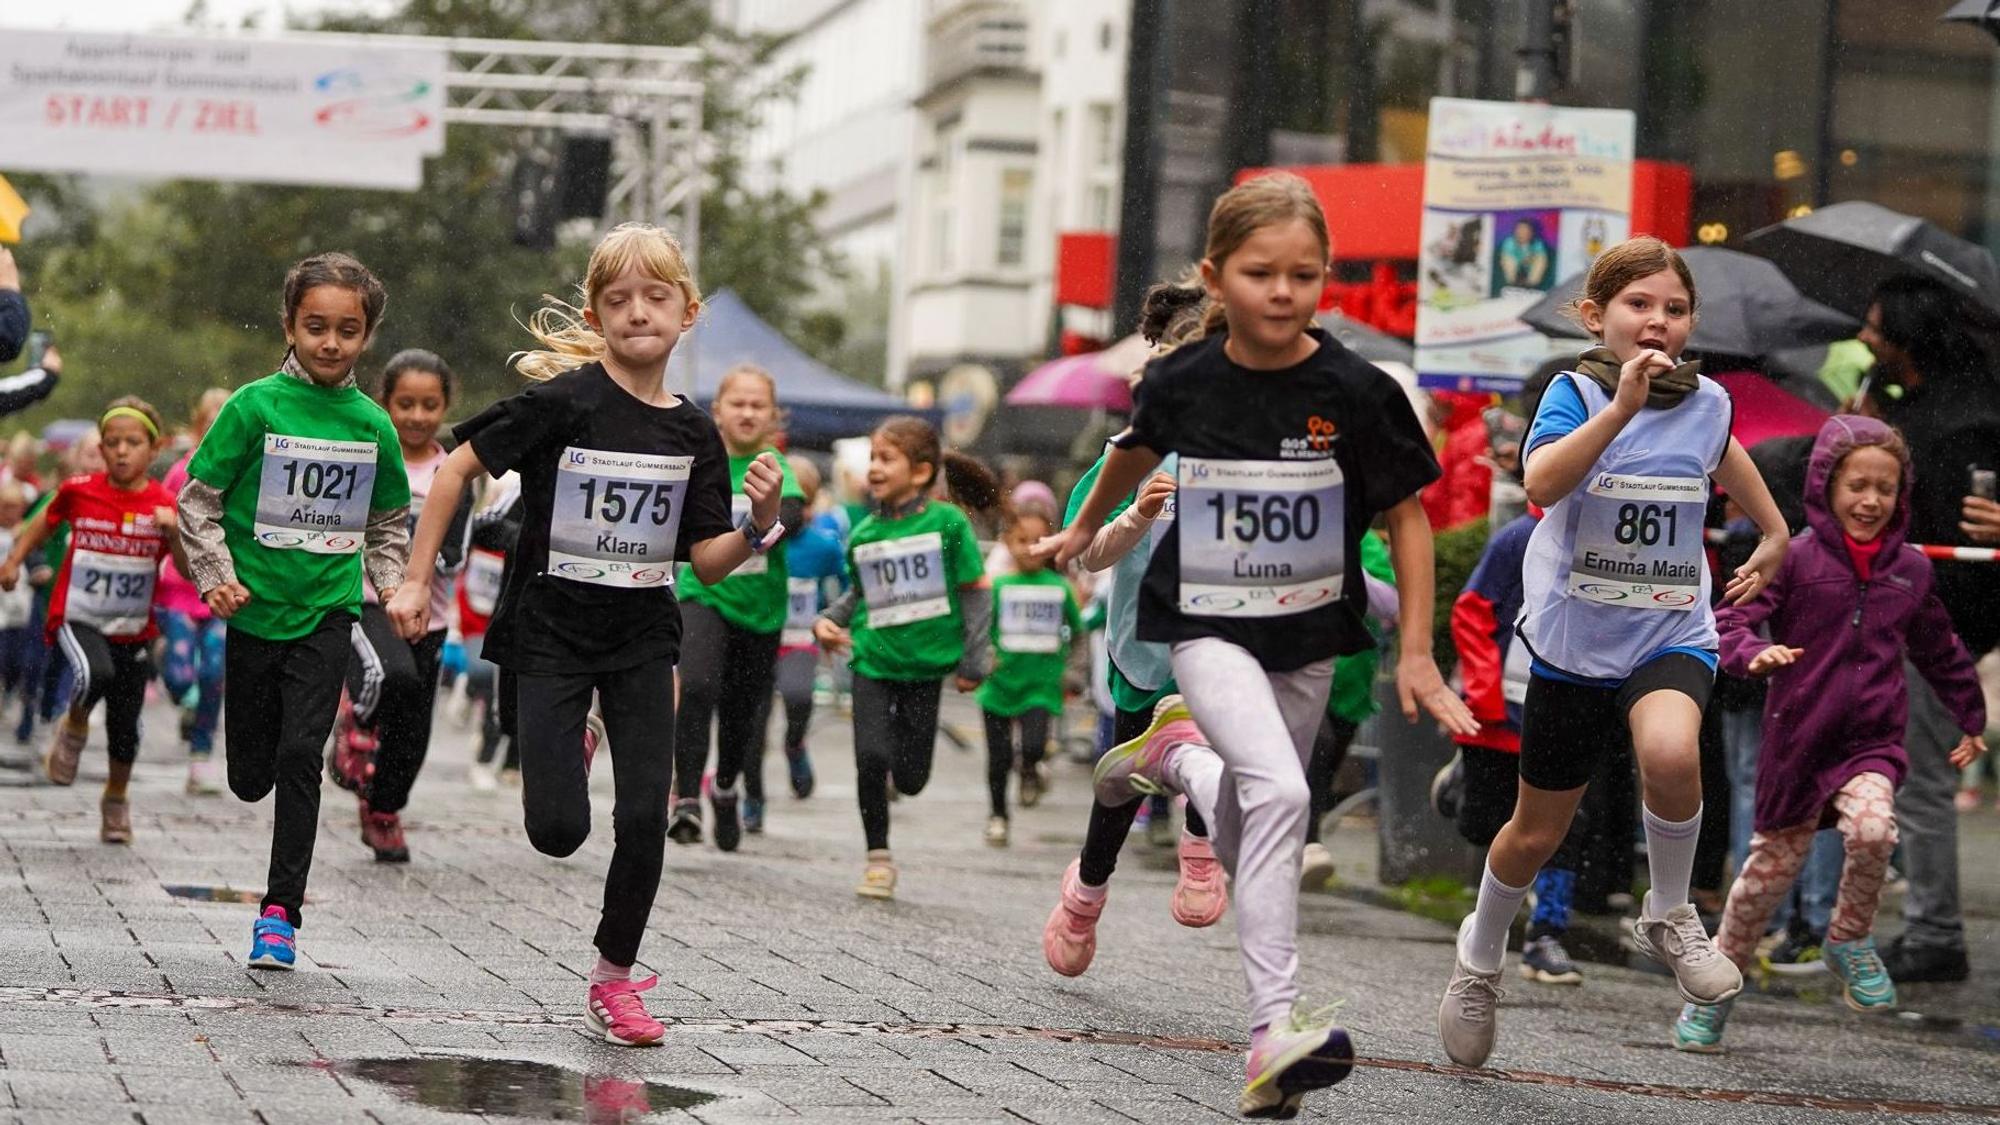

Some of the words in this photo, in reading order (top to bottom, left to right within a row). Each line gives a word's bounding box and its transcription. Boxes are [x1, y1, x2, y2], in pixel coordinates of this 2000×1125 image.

[46, 93, 150, 128] START
[193, 98, 261, 135] ZIEL
[275, 438, 289, 449] LG
[570, 451, 585, 465] LG
[1191, 463, 1209, 478] LG
[283, 459, 358, 500] 1021
[1598, 476, 1614, 489] LG
[579, 477, 674, 527] 1575
[290, 508, 342, 526] Ariana
[1206, 492, 1321, 544] 1560
[1614, 502, 1677, 547] 861
[596, 535, 648, 556] Klara
[870, 553, 929, 585] 1018
[1233, 558, 1293, 579] Luna
[1583, 551, 1647, 576] Emma
[1652, 560, 1697, 578] Marie
[85, 568, 147, 599] 2132
